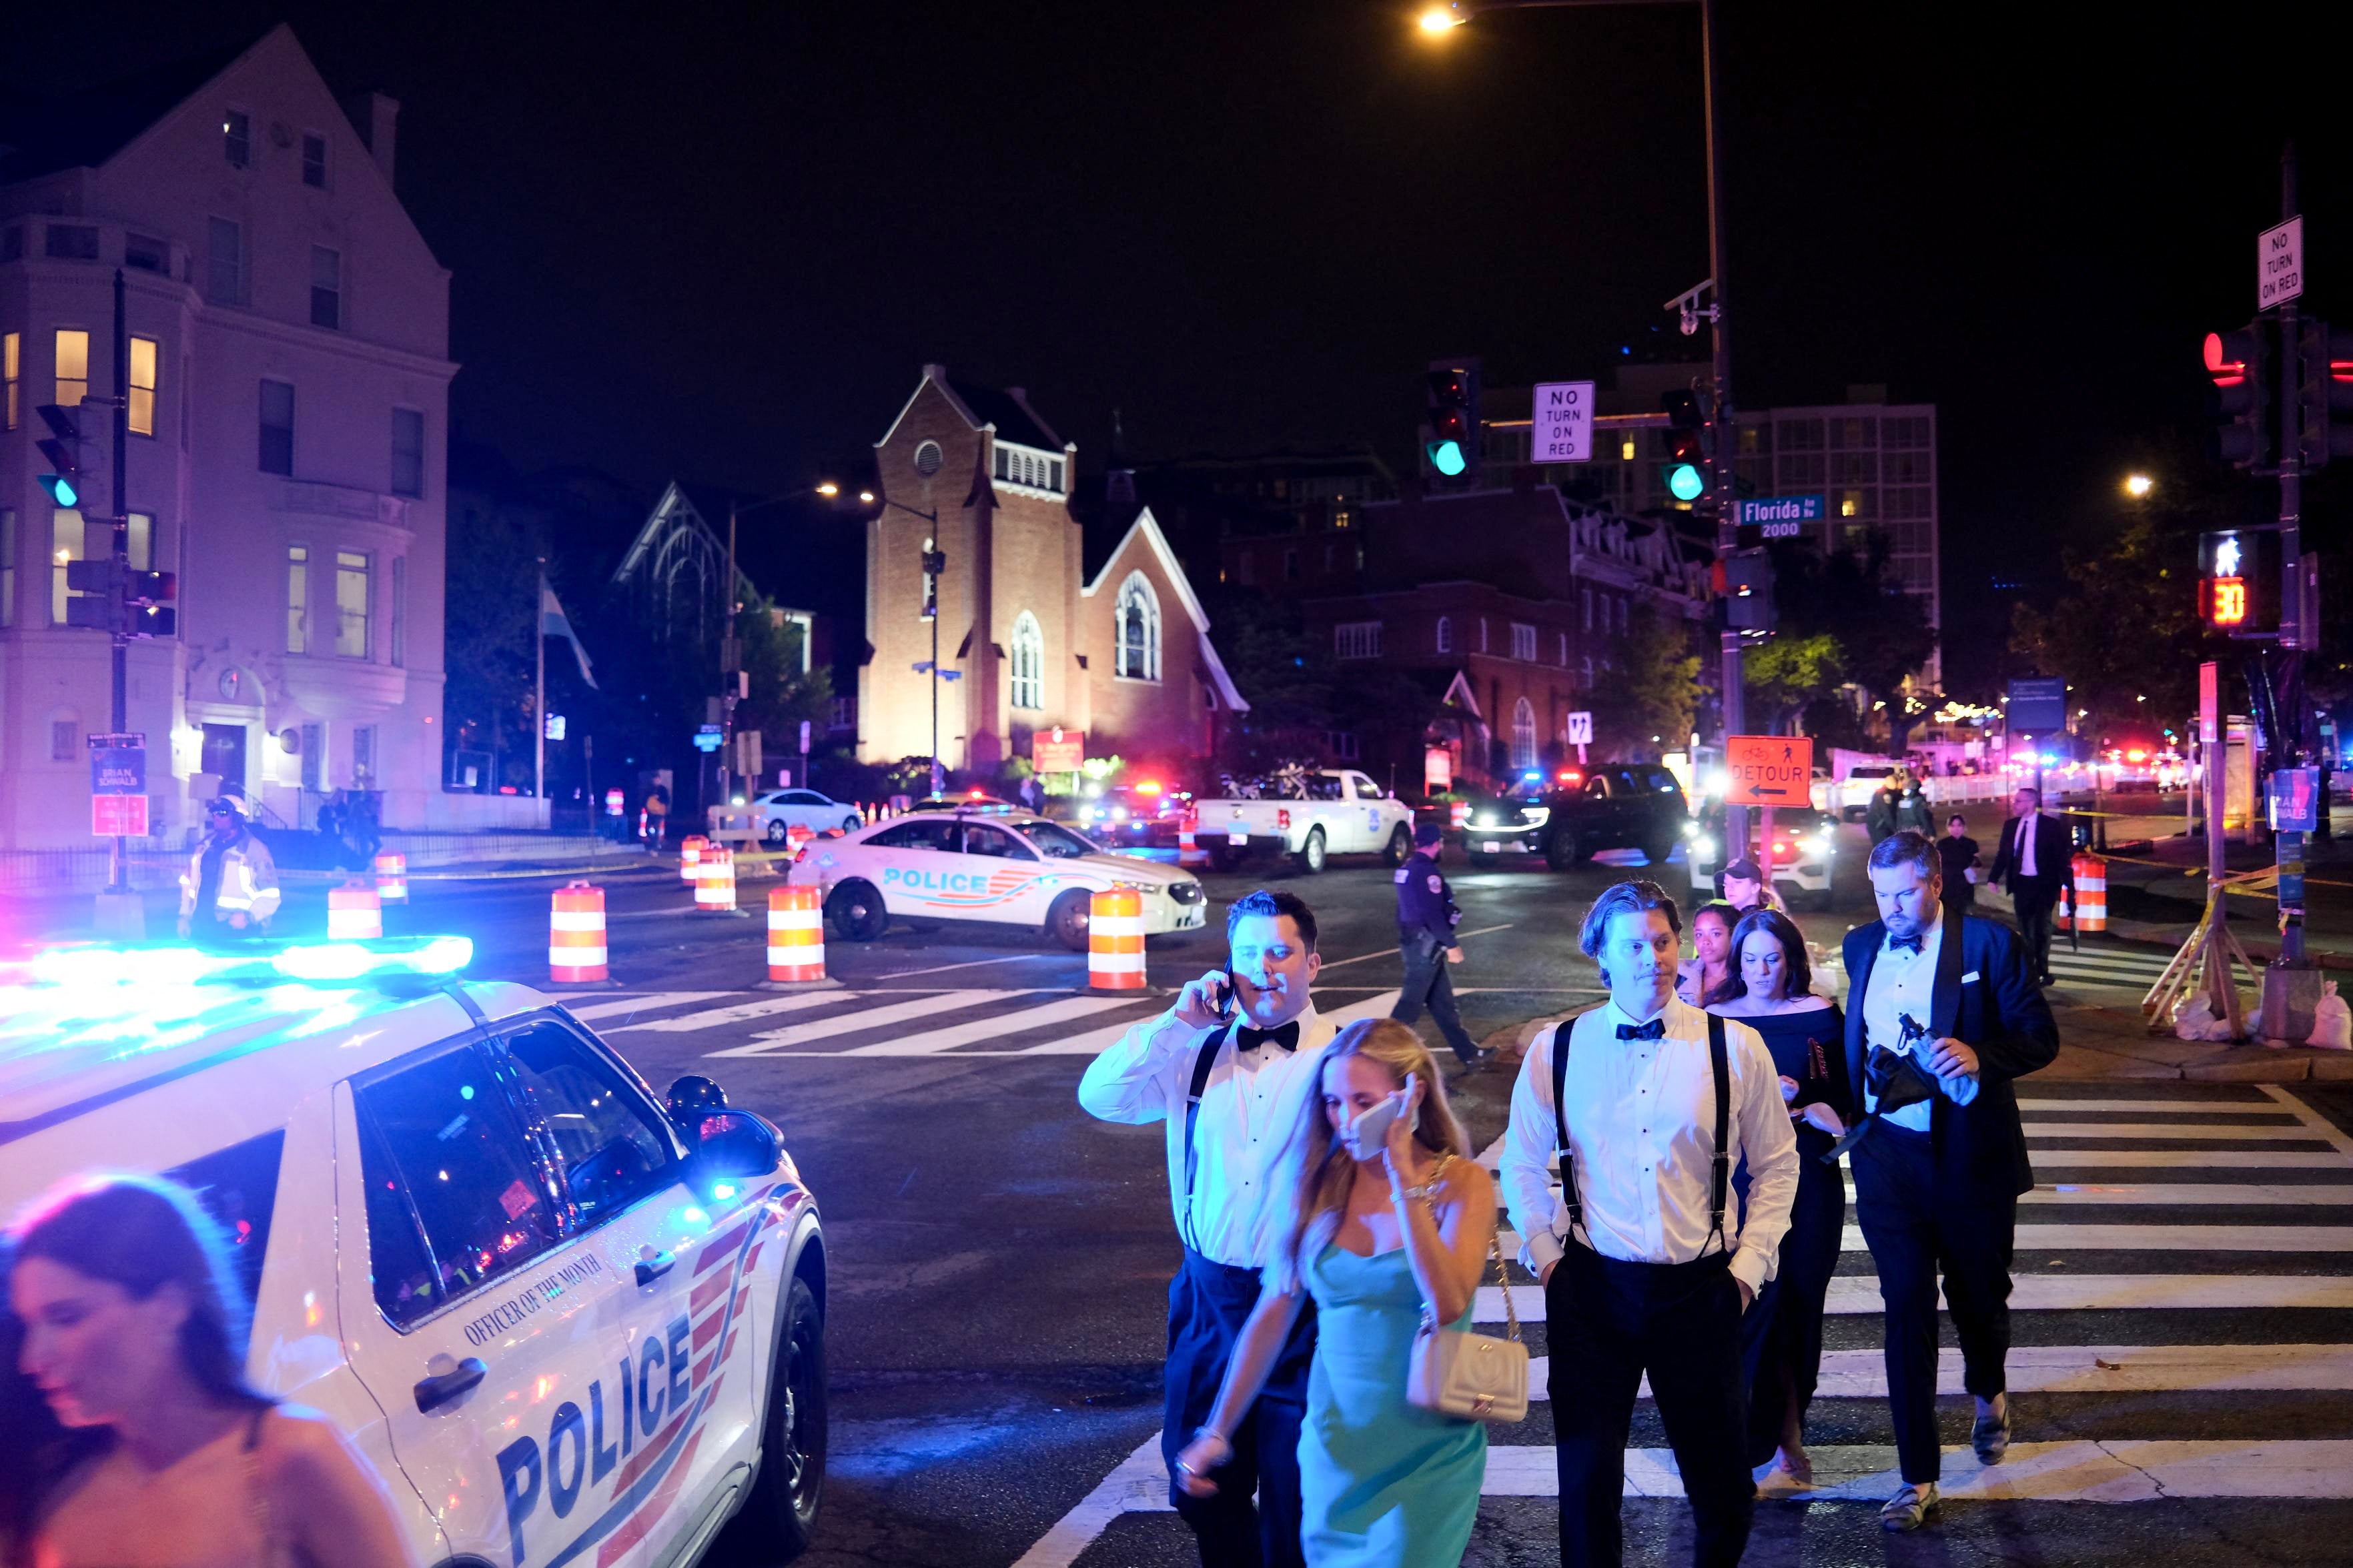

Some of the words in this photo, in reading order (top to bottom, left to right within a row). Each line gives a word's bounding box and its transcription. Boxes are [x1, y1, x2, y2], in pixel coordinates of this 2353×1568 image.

[2272, 234, 2287, 251] NO
[2268, 253, 2292, 274] TURN
[2263, 283, 2275, 298] ON
[2279, 273, 2298, 293] RED
[1552, 391, 1577, 404] NO
[1546, 410, 1580, 422] TURN
[1554, 427, 1572, 438] ON
[1550, 443, 1574, 455] RED
[1745, 501, 1799, 522] Florida
[1763, 524, 1798, 538] 2000
[2215, 585, 2244, 621] 30
[103, 768, 131, 777] BRIAN
[1733, 765, 1802, 781] DETOUR
[884, 868, 987, 894] POLICE
[464, 1301, 526, 1346] OFFICER
[519, 1289, 541, 1313] OF
[534, 1275, 565, 1302] THE
[558, 1254, 602, 1286] MONTH
[496, 1313, 690, 1568] POLICE
